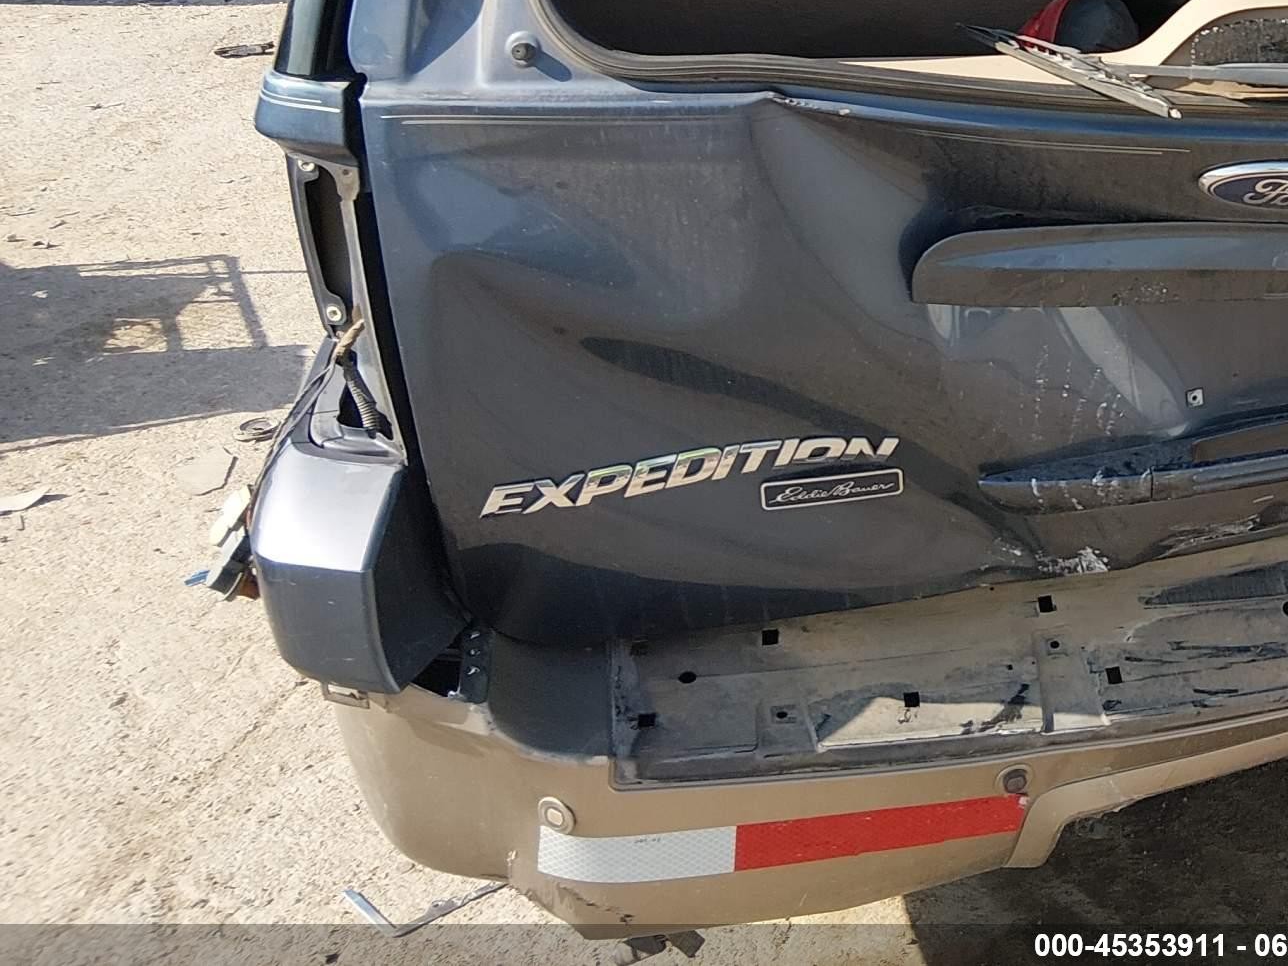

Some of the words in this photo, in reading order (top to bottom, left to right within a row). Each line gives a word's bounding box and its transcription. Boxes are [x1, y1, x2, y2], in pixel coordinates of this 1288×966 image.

[478, 436, 900, 518] EXPEDITION
[768, 486, 829, 504] Eddie
[828, 480, 895, 497] Bauer
